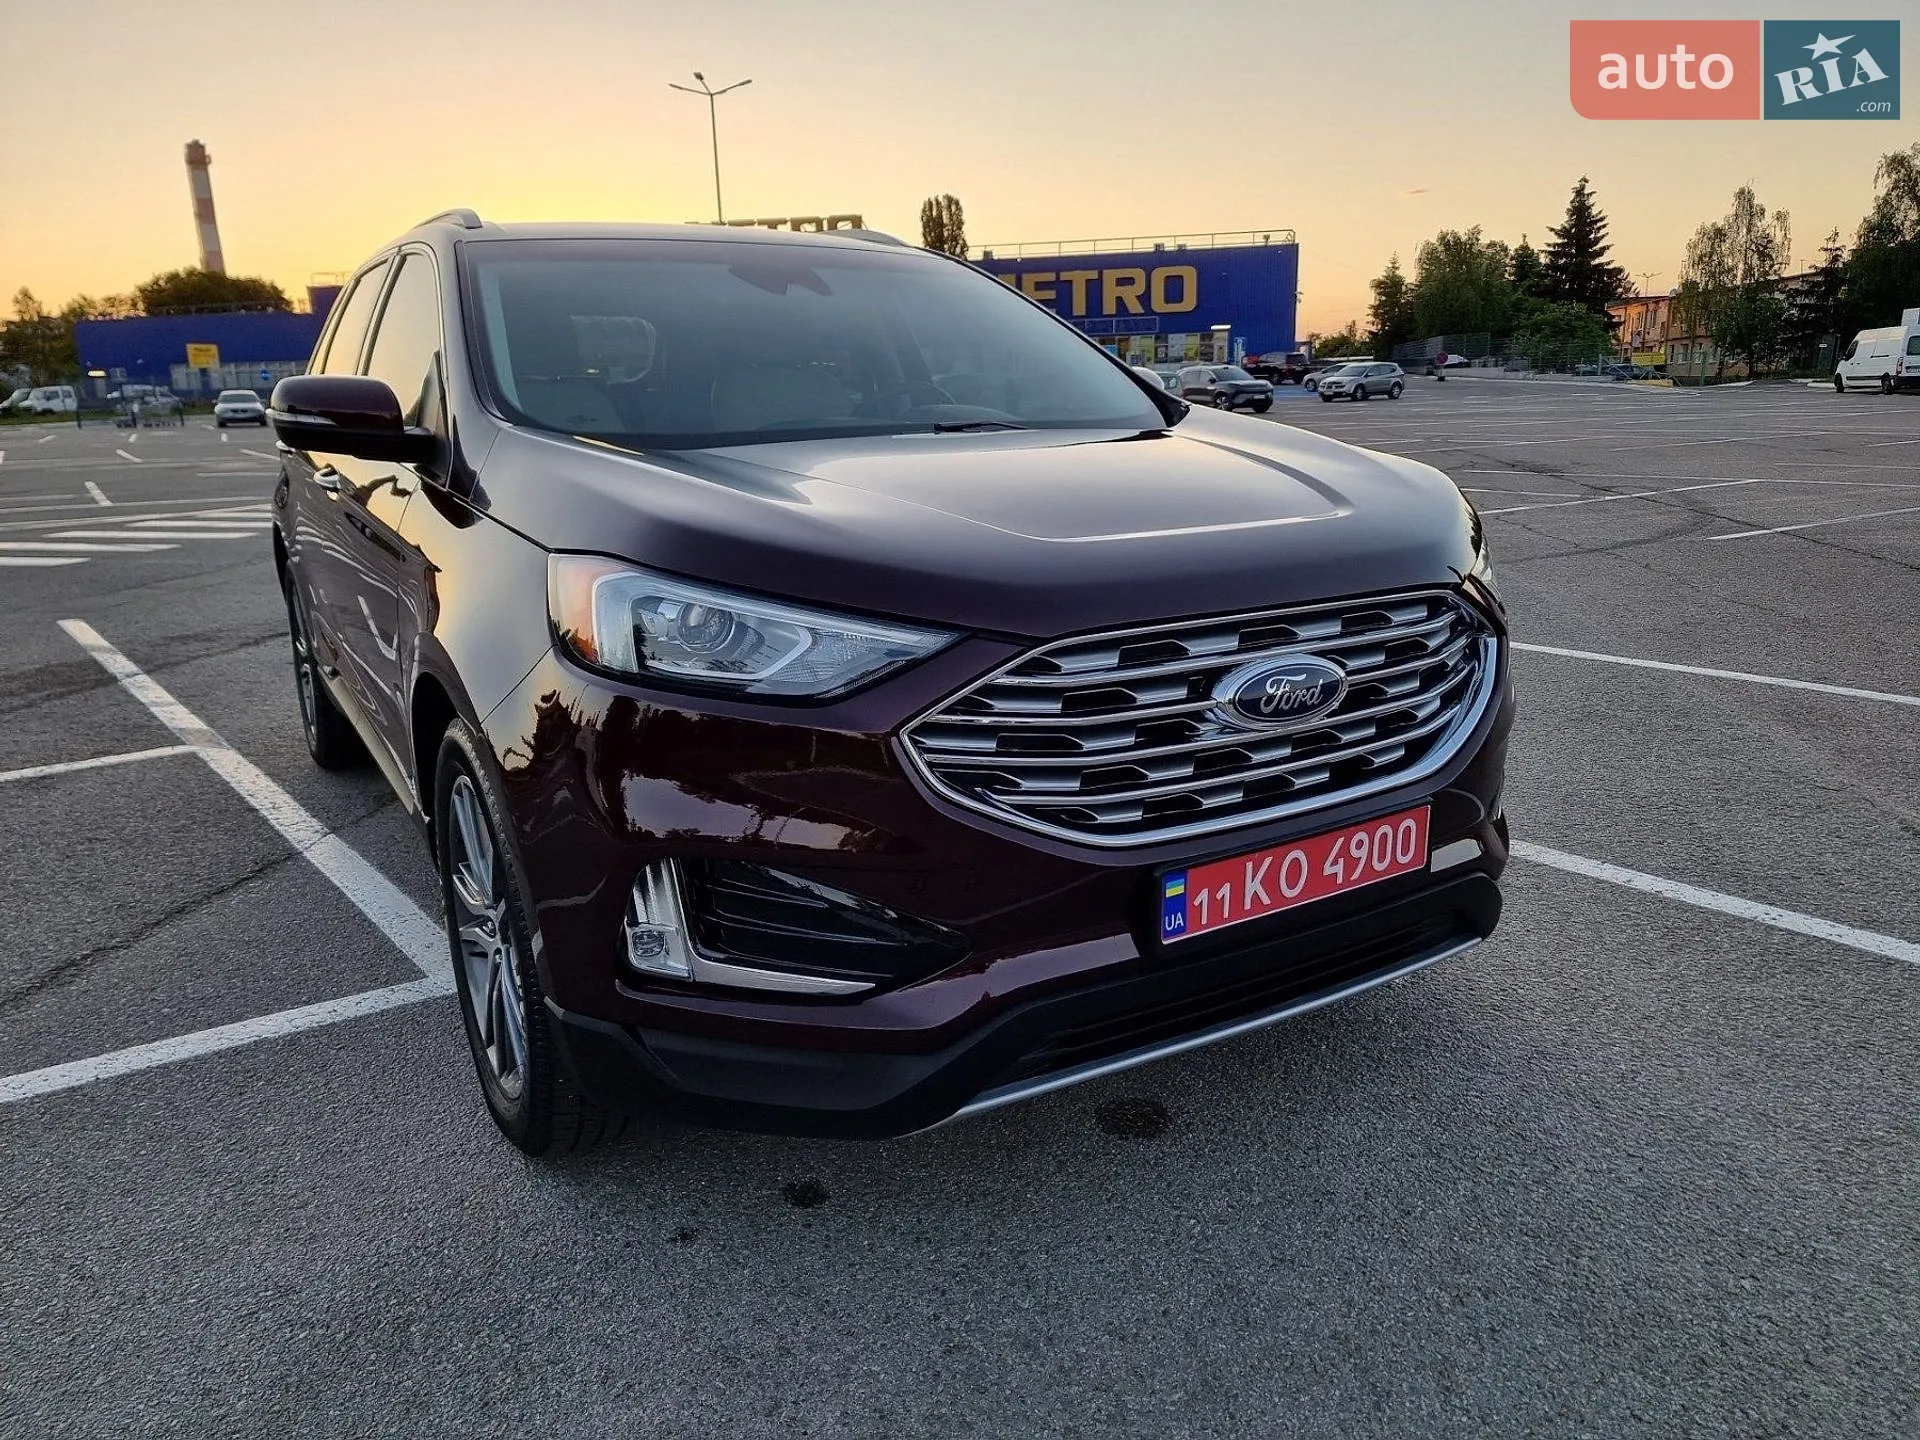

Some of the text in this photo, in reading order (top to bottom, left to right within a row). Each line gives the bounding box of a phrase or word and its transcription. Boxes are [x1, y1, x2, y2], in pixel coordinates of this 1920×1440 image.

[997, 265, 1198, 317] ETRO
[1259, 673, 1324, 714] Ford
[1193, 881, 1231, 925] 11
[1322, 817, 1418, 886] 4900
[1165, 911, 1185, 931] UA
